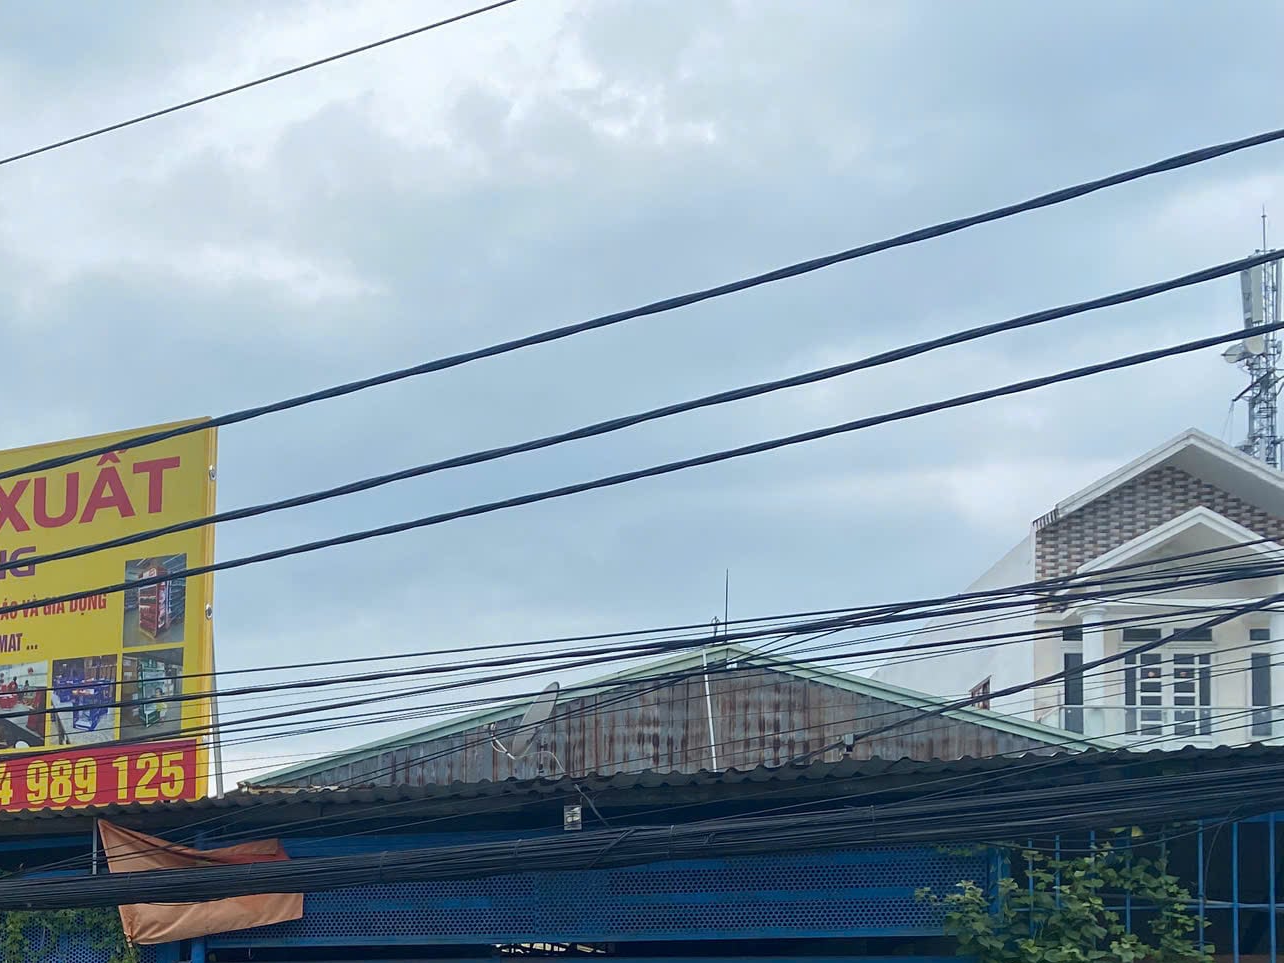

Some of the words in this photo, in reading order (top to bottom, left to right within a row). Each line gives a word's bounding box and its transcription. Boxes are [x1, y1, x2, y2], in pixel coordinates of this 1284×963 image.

[70, 592, 107, 616] DỤNG
[26, 757, 97, 804] 989
[112, 752, 184, 800] 125
